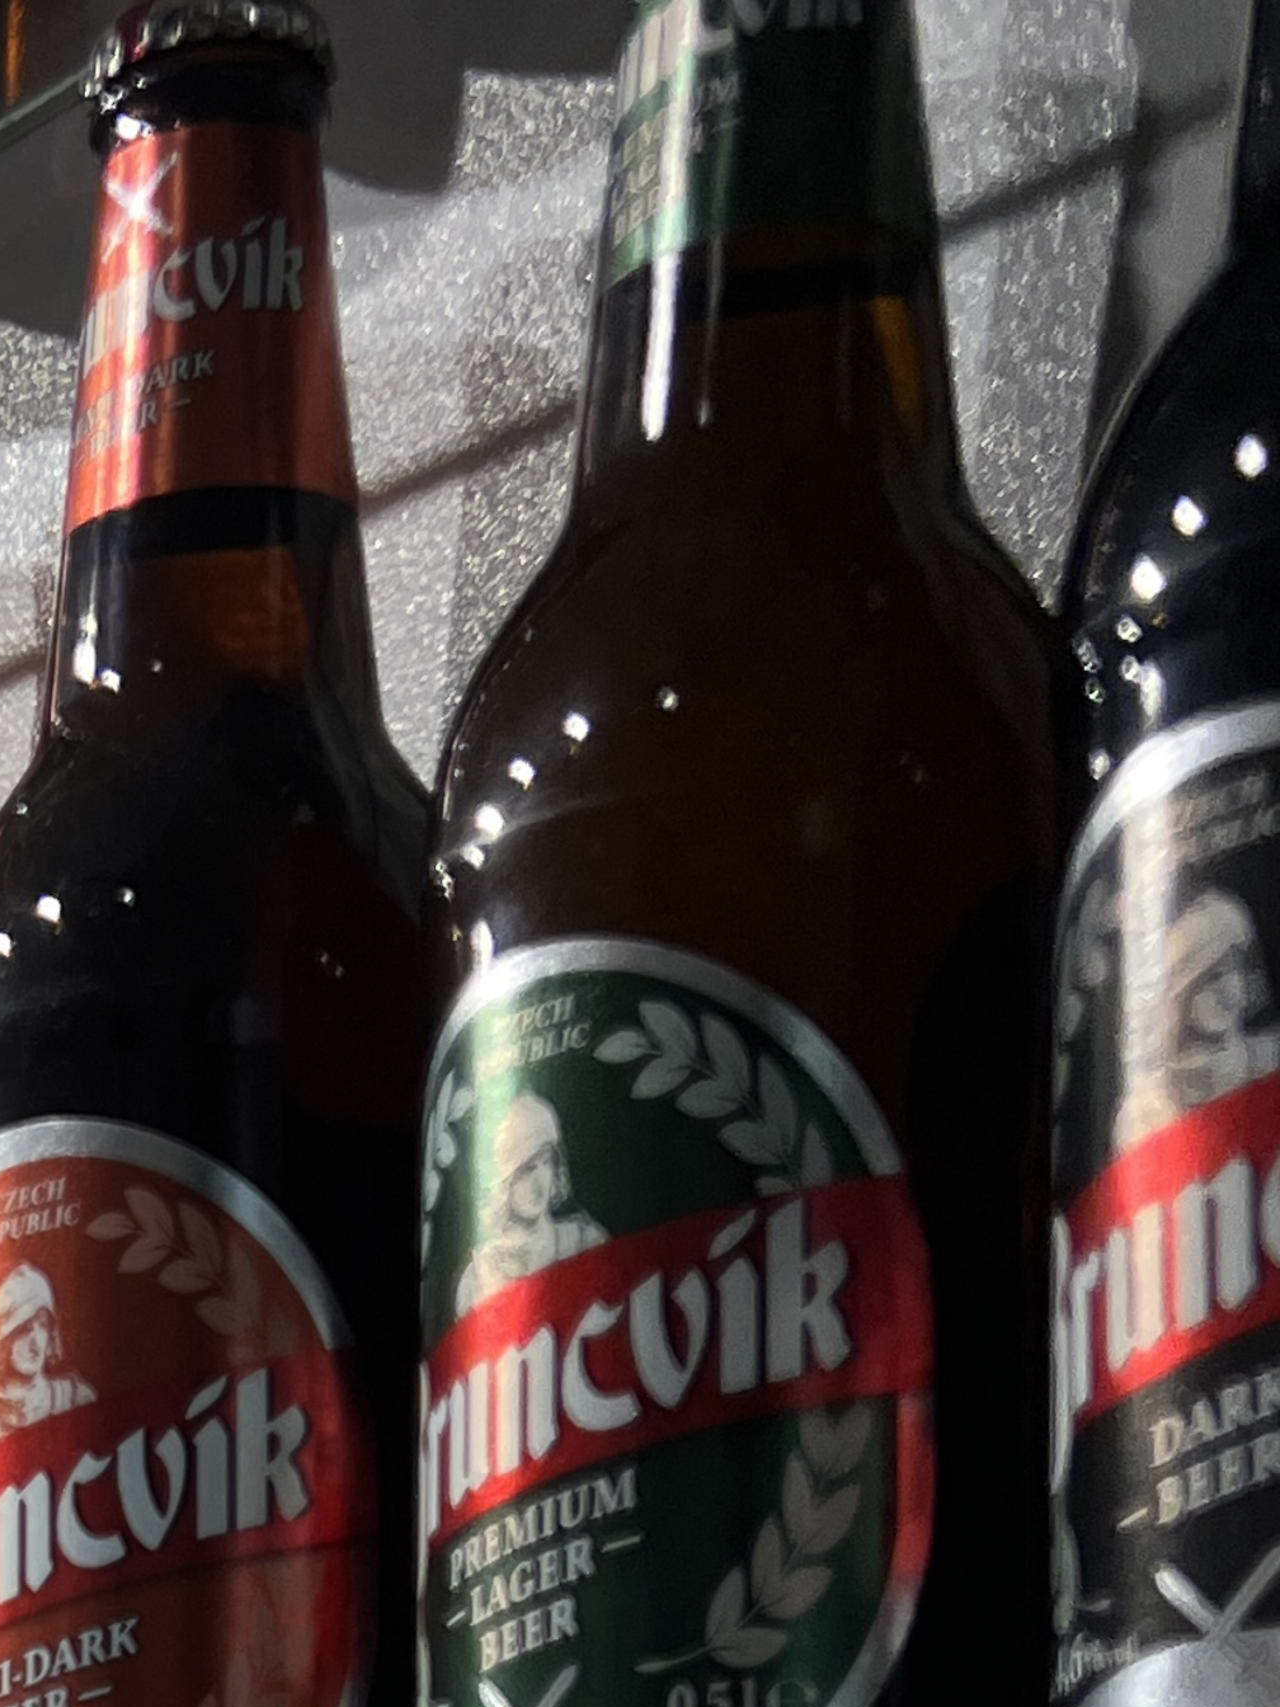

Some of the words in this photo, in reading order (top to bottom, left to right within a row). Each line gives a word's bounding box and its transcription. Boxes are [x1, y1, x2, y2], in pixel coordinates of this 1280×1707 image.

[449, 1466, 638, 1593] PREMIUM
[468, 1533, 597, 1625] LAGER
[478, 1597, 580, 1675] BEER
